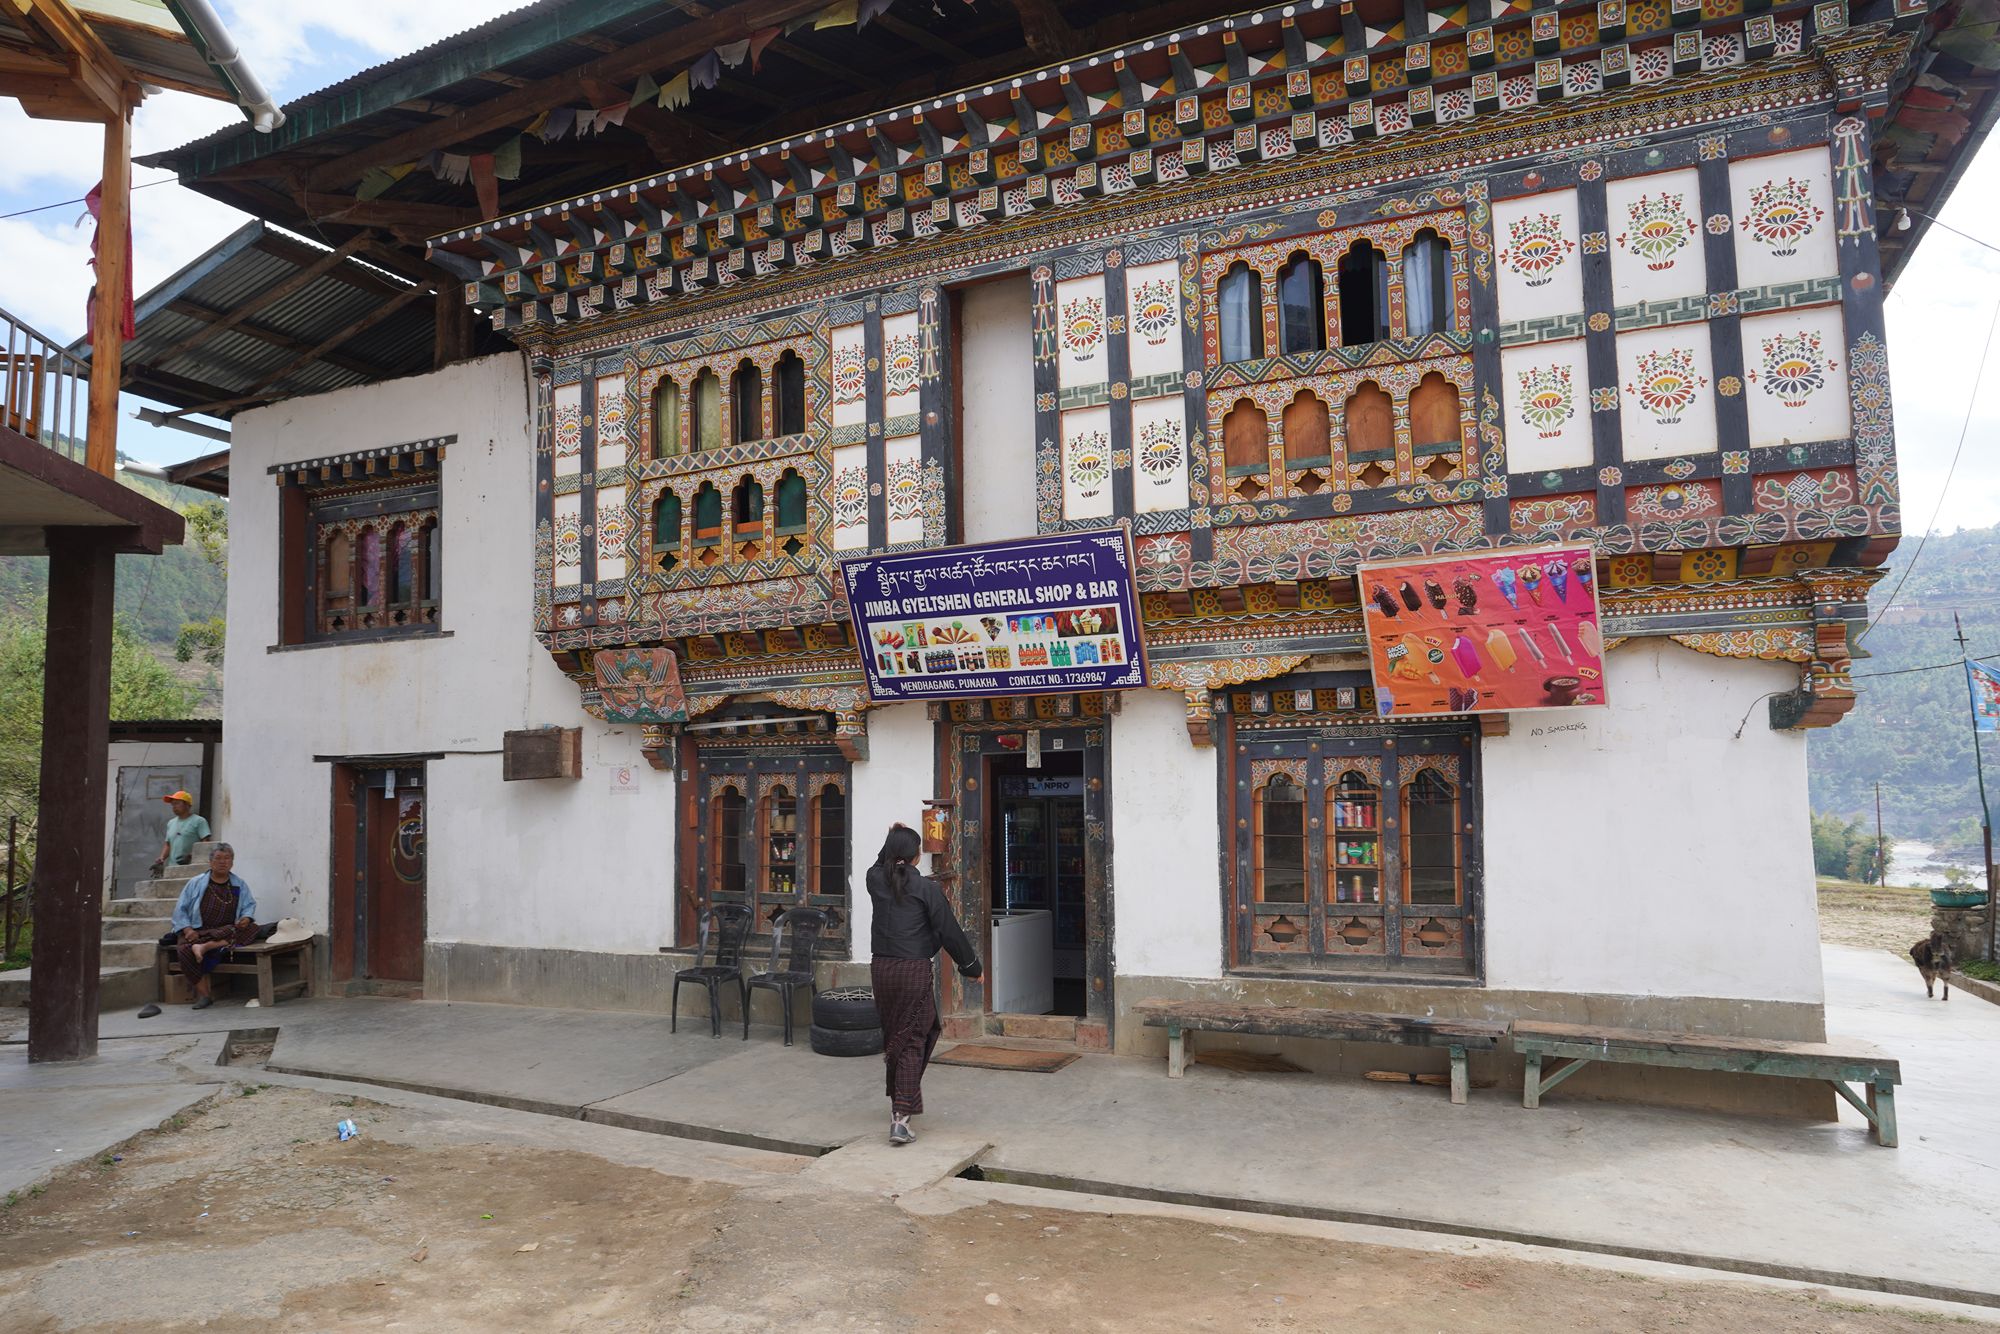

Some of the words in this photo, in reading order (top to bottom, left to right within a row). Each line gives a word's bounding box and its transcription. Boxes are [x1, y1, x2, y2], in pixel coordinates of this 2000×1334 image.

[865, 600, 901, 617] JIMBA
[902, 593, 971, 614] GYELTSHEN
[973, 587, 1034, 608] GENERAL
[1035, 584, 1072, 603] SHOP
[1076, 583, 1087, 600] &
[1089, 580, 1119, 598] BAR
[959, 677, 998, 689] PUNAKHA
[1009, 674, 1046, 686] CONTACT
[1048, 674, 1064, 684] NO:
[1065, 671, 1106, 683] 17369847
[1531, 728, 1543, 737] NO
[1547, 722, 1588, 734] SMOKING
